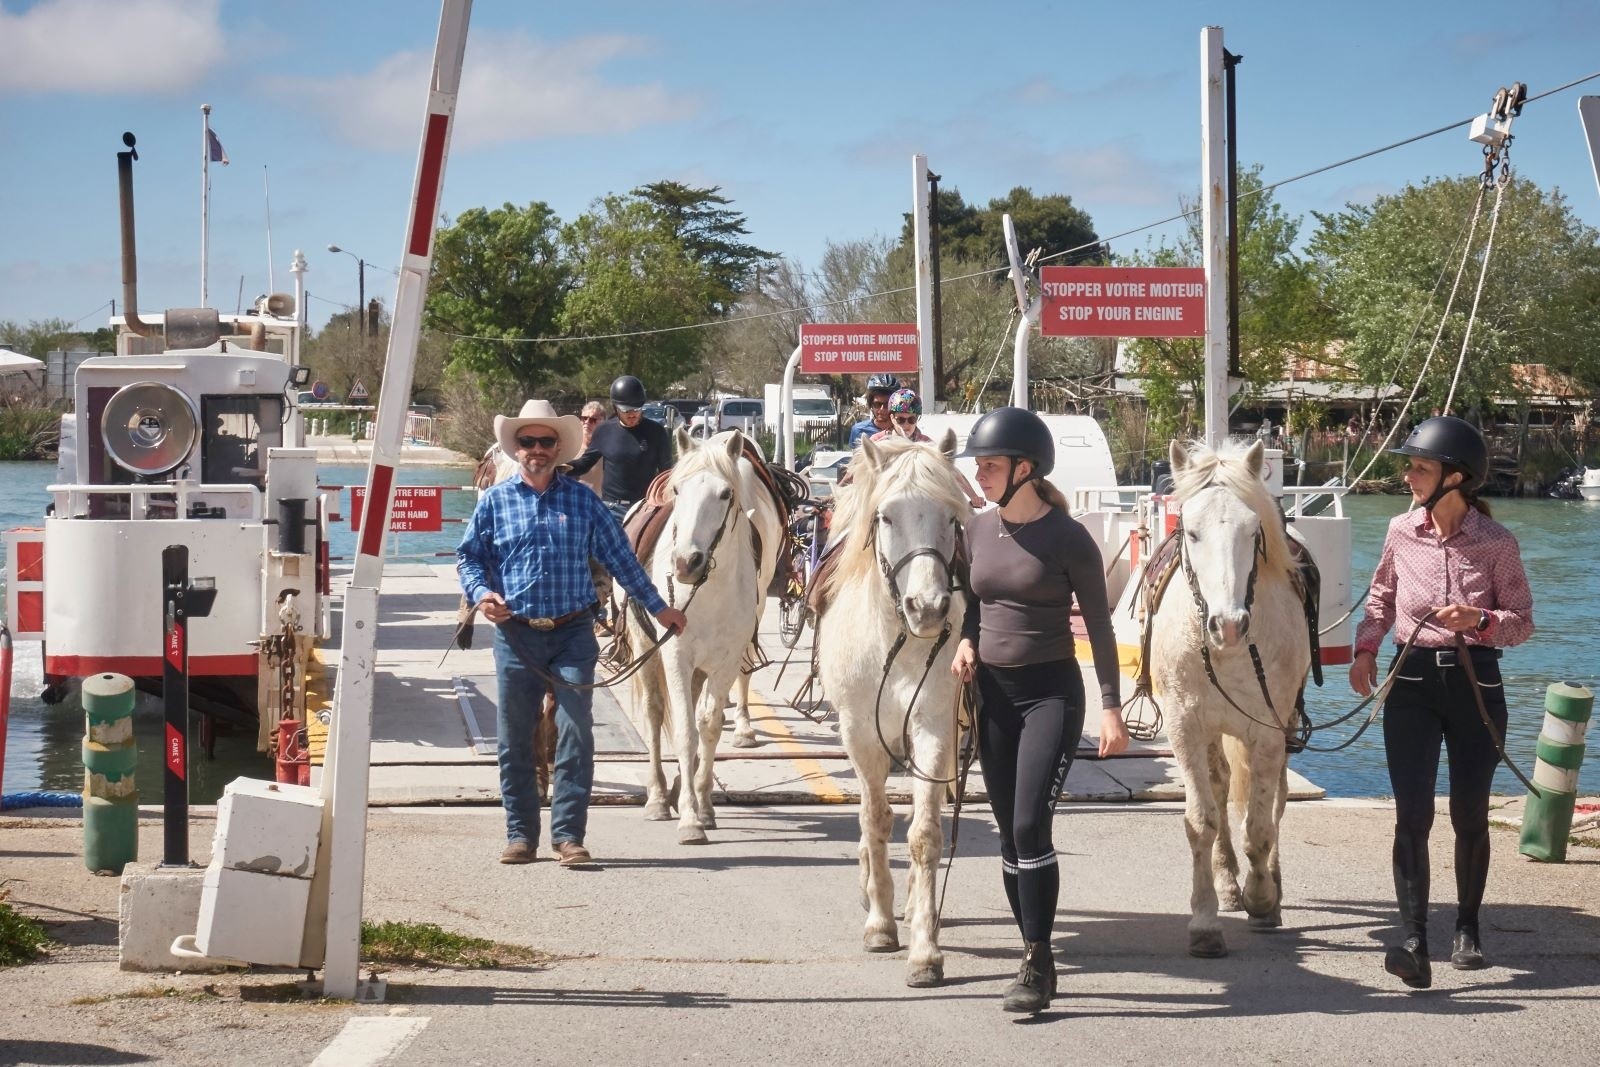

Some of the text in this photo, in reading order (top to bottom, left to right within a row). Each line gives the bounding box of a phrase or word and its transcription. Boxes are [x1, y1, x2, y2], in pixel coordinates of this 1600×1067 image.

[1043, 282, 1204, 298] STOPPER VOTRE MOTEUR
[1059, 306, 1183, 321] STOP YOUR ENGINE
[802, 334, 917, 345] STOPPER VOTRE MOTEUR
[814, 351, 902, 362] STOP YOUR ENGINE
[1047, 753, 1068, 811] ARIAT
